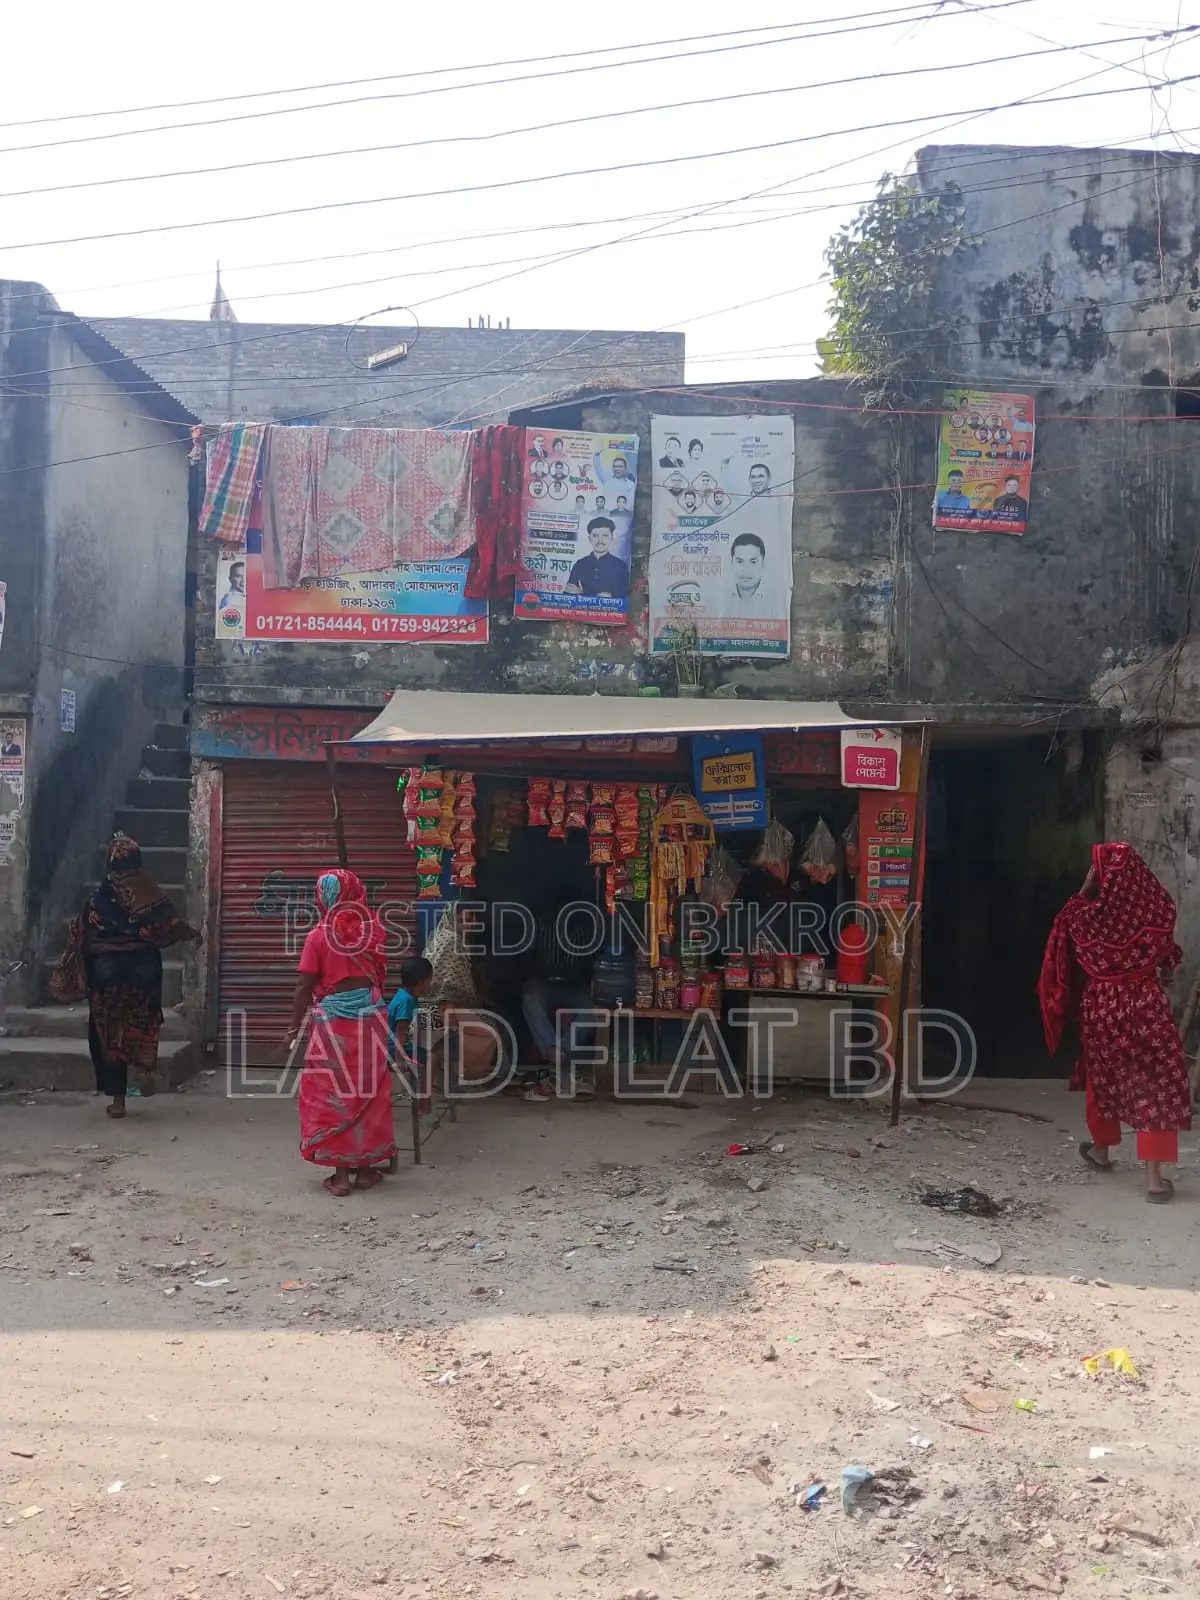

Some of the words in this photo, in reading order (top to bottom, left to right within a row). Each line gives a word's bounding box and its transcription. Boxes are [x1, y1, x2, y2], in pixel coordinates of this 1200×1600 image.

[524, 553, 547, 570] কর্মী
[550, 559, 573, 573] সভা
[359, 579, 401, 592] আদাবর,
[404, 580, 460, 593] মোহাম্মদপুর
[340, 598, 396, 610] ঢাকা-১২০৭
[256, 616, 368, 635] 01721-854444,
[856, 752, 887, 768] বিকাশ
[712, 776, 731, 785] করা
[732, 774, 747, 785] হয়
[856, 767, 887, 779] পেমেন্ট
